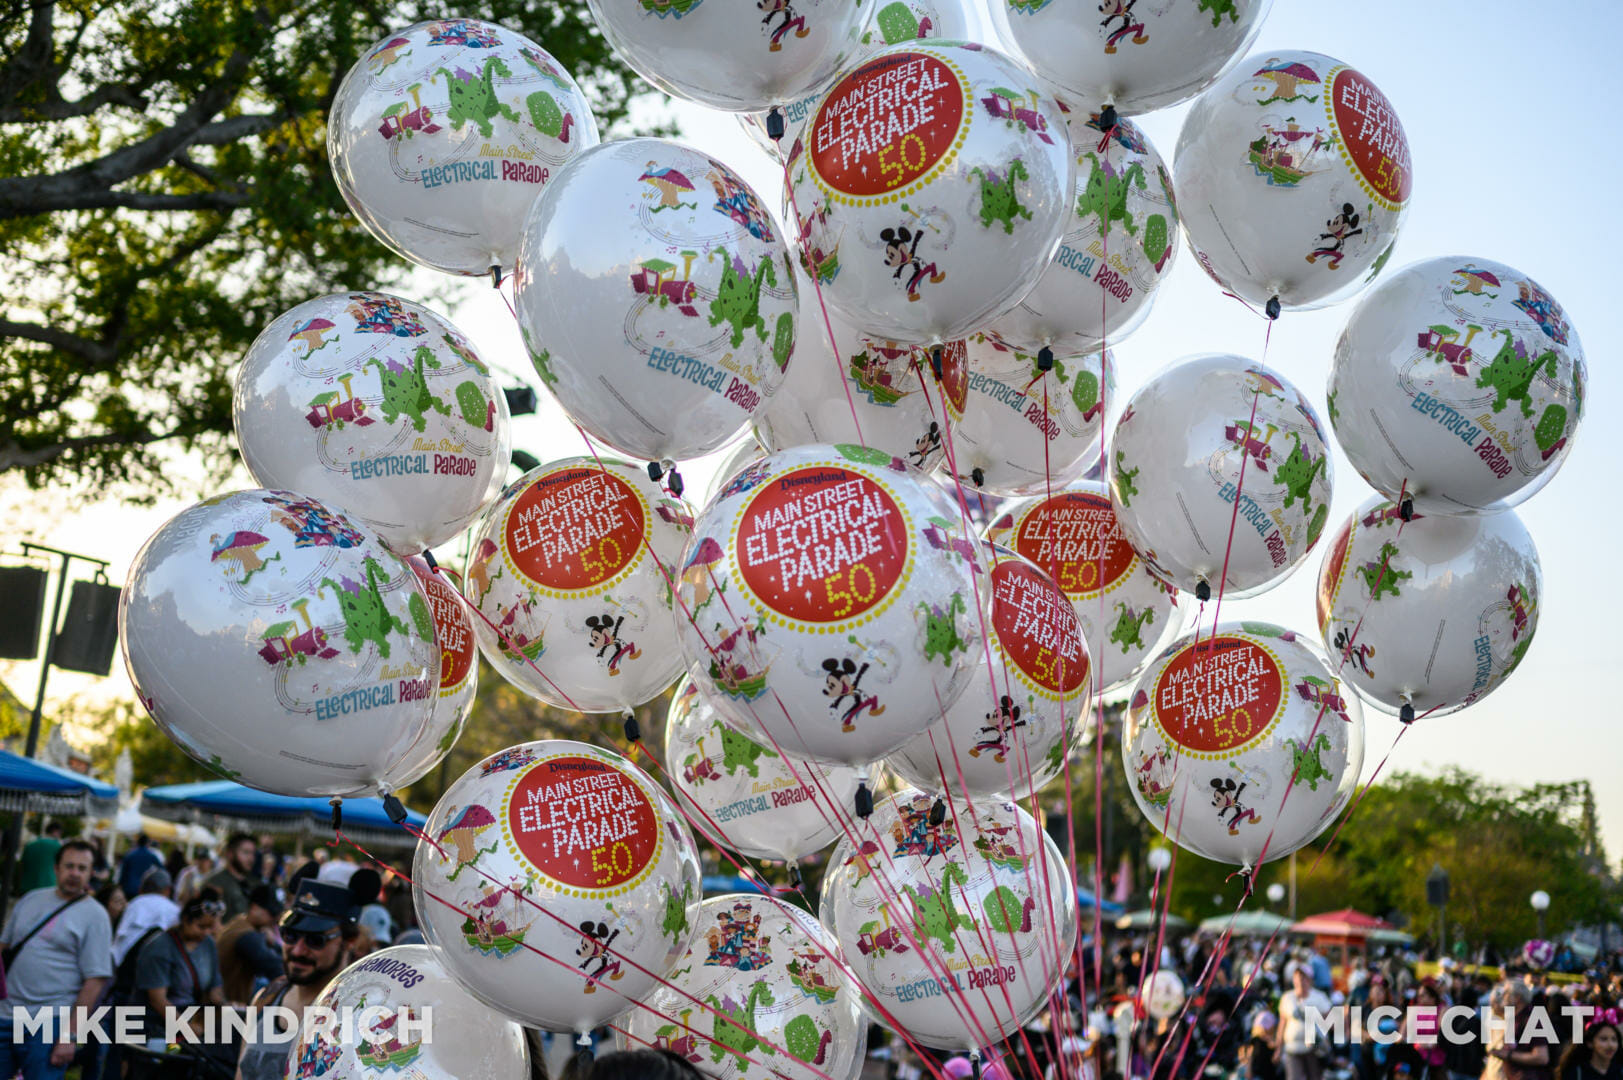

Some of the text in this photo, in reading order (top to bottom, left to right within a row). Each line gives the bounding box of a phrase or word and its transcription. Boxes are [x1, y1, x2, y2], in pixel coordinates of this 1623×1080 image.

[817, 67, 949, 154] ELECTRICAL
[825, 58, 928, 122] MAIN STREET
[478, 143, 536, 161] Main Street
[841, 93, 935, 171] PARADE
[878, 133, 926, 187] 50
[1374, 156, 1402, 196] 50
[412, 437, 465, 453] Main Street
[1475, 413, 1496, 436] Main
[518, 473, 606, 527] MAIN STREET
[537, 469, 591, 491] Disneyland
[779, 471, 847, 491] Disneyland
[513, 482, 629, 553] ELECTRICAL
[746, 491, 891, 567] ELECTRICAL
[754, 478, 864, 533] MAIN STREET
[1037, 509, 1115, 521] MAIN STREE
[542, 504, 624, 569] PARADE
[580, 537, 622, 582] 50
[780, 521, 882, 592] PARADE
[1037, 540, 1116, 562] PARADE
[825, 563, 876, 617] 50
[1007, 570, 1043, 597] MAIN
[1061, 561, 1098, 590] 50
[995, 578, 1081, 639] ELECTRICA
[1013, 610, 1081, 663] PARADE
[380, 664, 401, 680] Main
[1033, 646, 1066, 687] 50
[1162, 656, 1271, 710] ELECTRICAL
[1169, 646, 1254, 685] MAN STREET
[1183, 678, 1259, 729] PARADE
[1213, 708, 1252, 748] 50
[519, 784, 644, 833] ELECTRICAL
[527, 772, 622, 805] MAIN STREET
[552, 809, 639, 858] PARADE
[591, 842, 632, 884] 50
